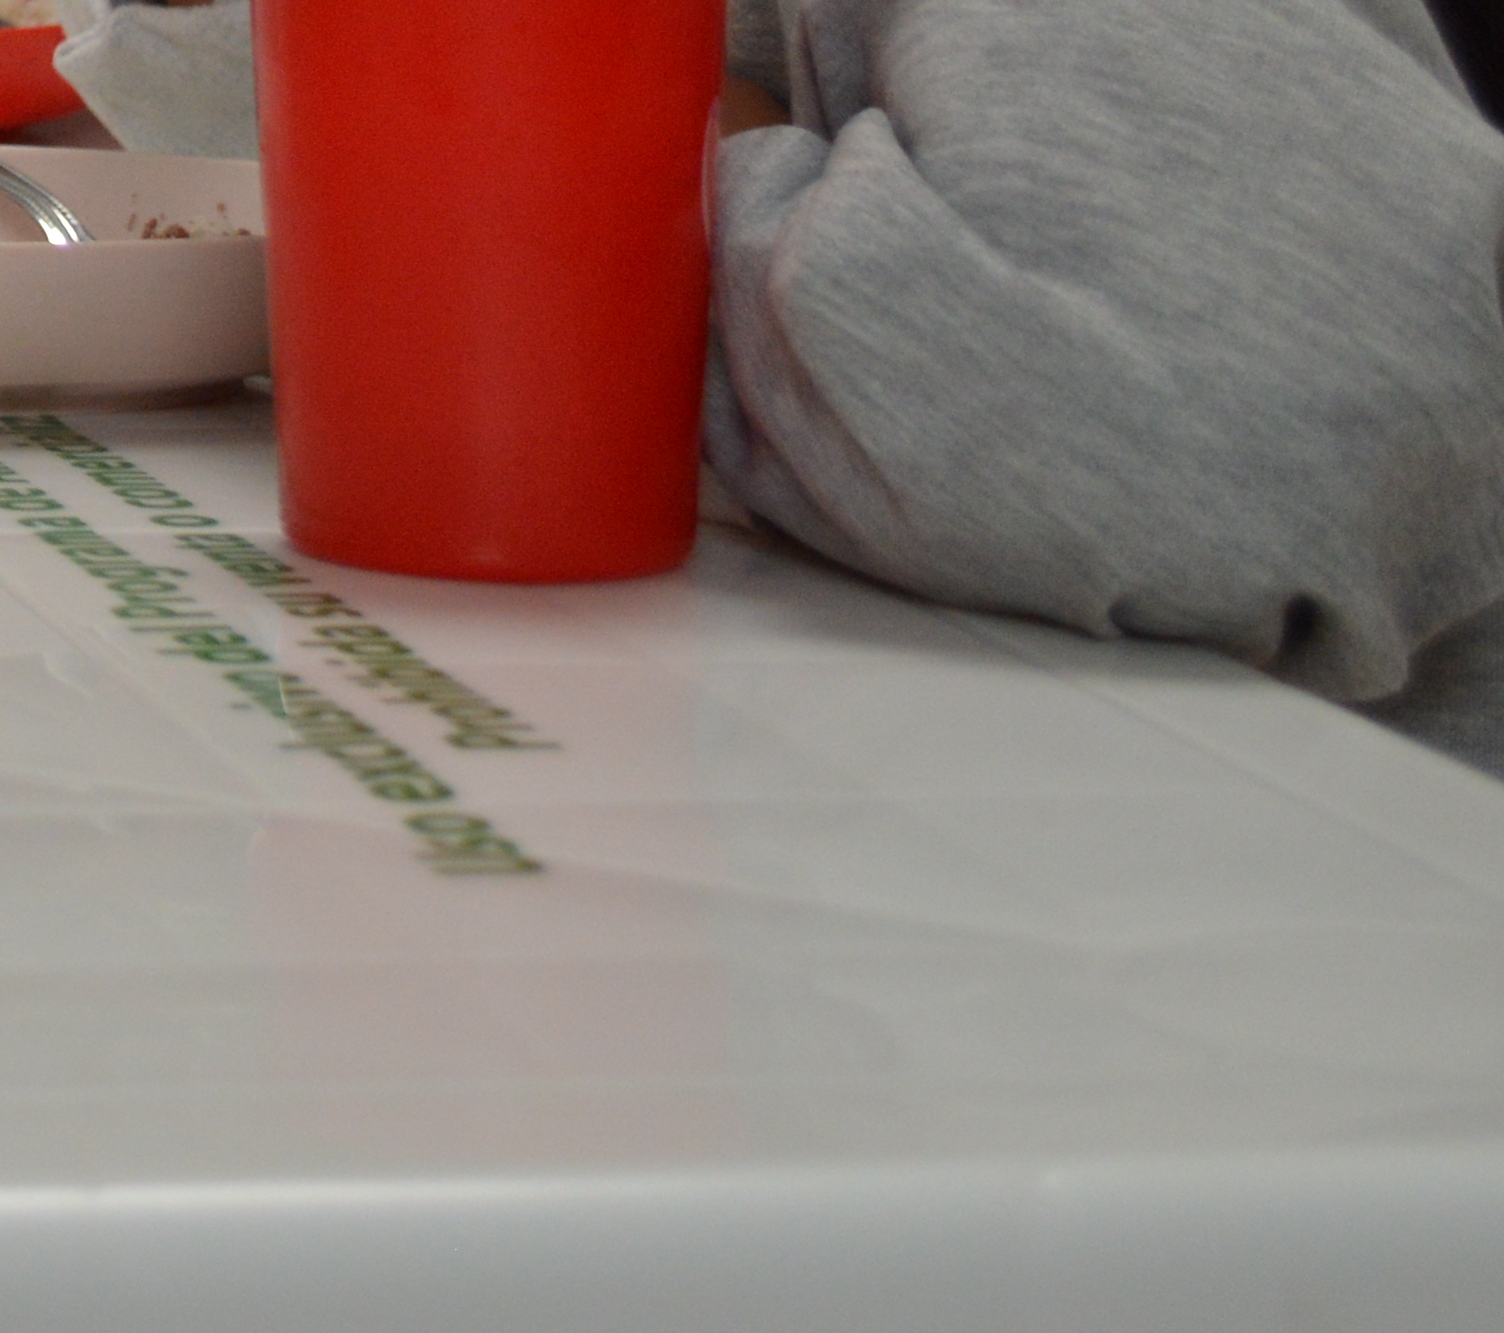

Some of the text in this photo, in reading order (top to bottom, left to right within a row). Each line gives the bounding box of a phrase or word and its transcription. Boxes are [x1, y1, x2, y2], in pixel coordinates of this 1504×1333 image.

[149, 513, 220, 528] o
[17, 516, 217, 618] Programa
[172, 532, 312, 587] venta
[265, 592, 364, 618] su
[129, 624, 273, 664] del
[297, 623, 562, 750] Prohibida
[222, 669, 456, 803] exclusivo
[404, 810, 548, 877] Uso
